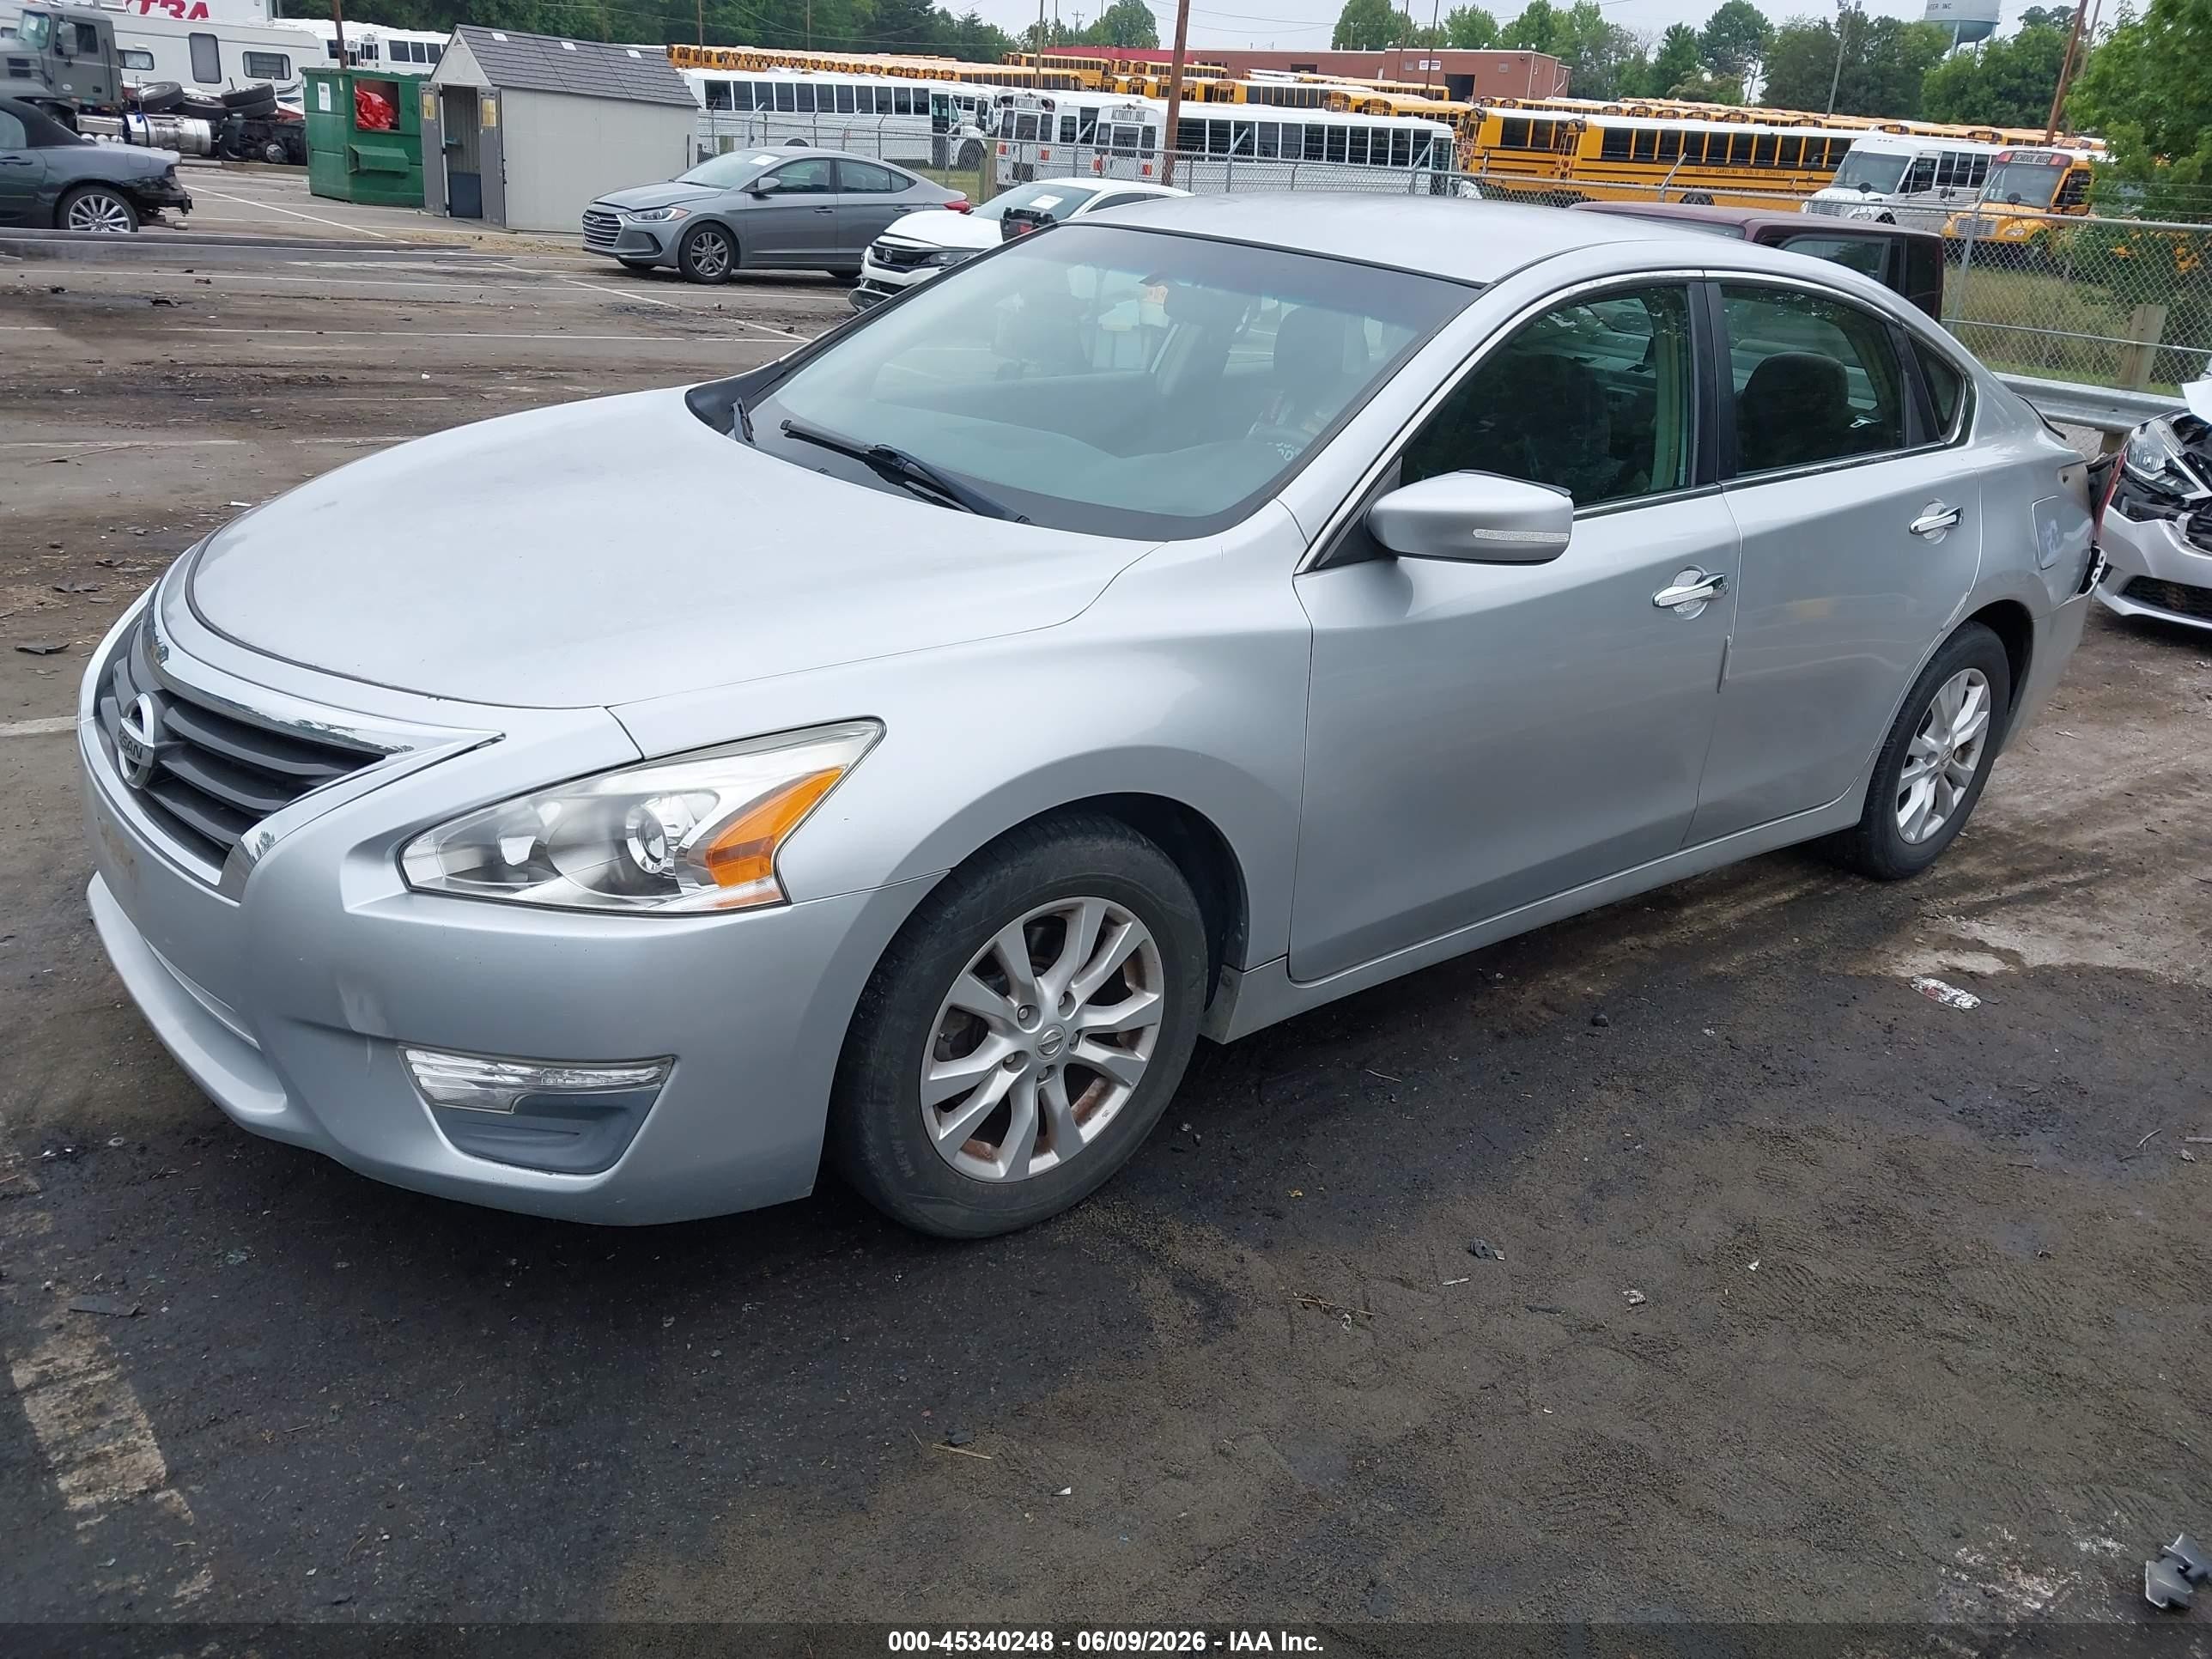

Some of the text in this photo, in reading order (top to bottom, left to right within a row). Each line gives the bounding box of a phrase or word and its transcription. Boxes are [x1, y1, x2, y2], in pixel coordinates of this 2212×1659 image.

[1111, 109, 1146, 122] ACTIVITY BUS
[2014, 154, 2048, 163] SCHOOL BUS
